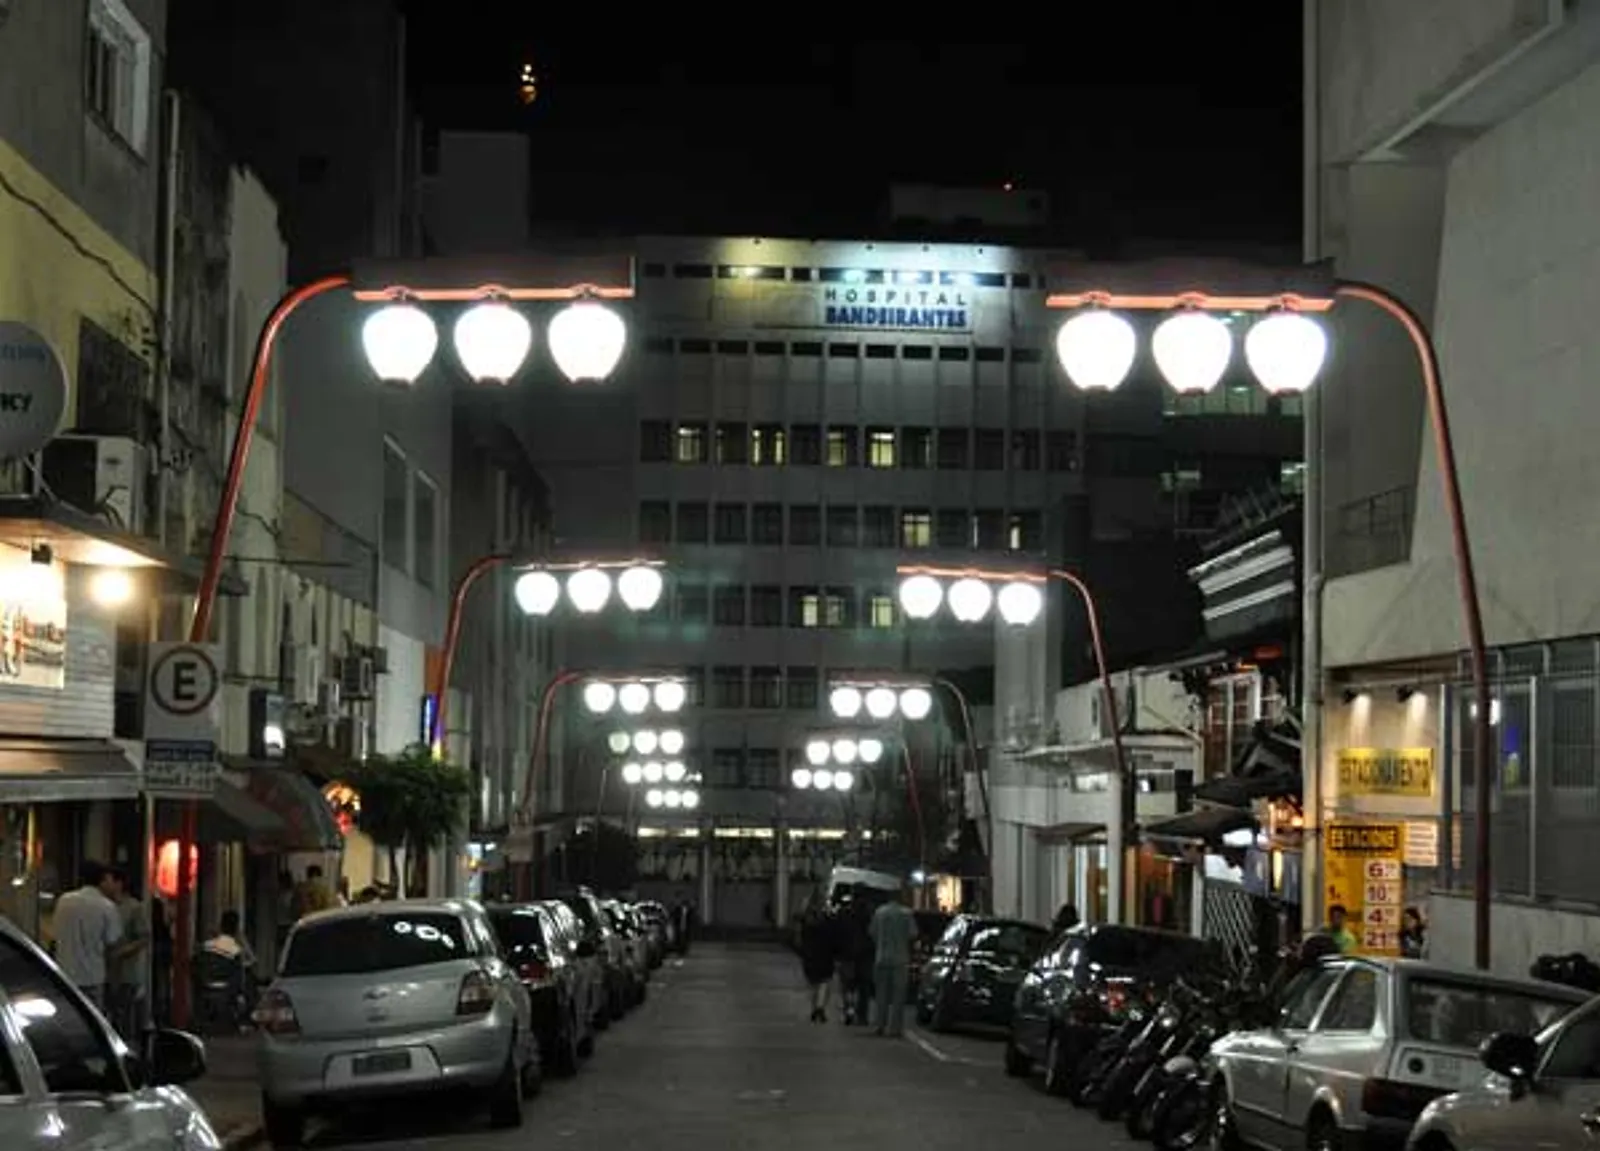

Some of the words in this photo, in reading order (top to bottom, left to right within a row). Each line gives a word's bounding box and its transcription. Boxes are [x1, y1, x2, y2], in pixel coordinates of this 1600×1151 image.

[825, 288, 966, 305] HOSPITAL
[826, 306, 967, 328] BANDEIRANTES
[173, 661, 198, 701] E
